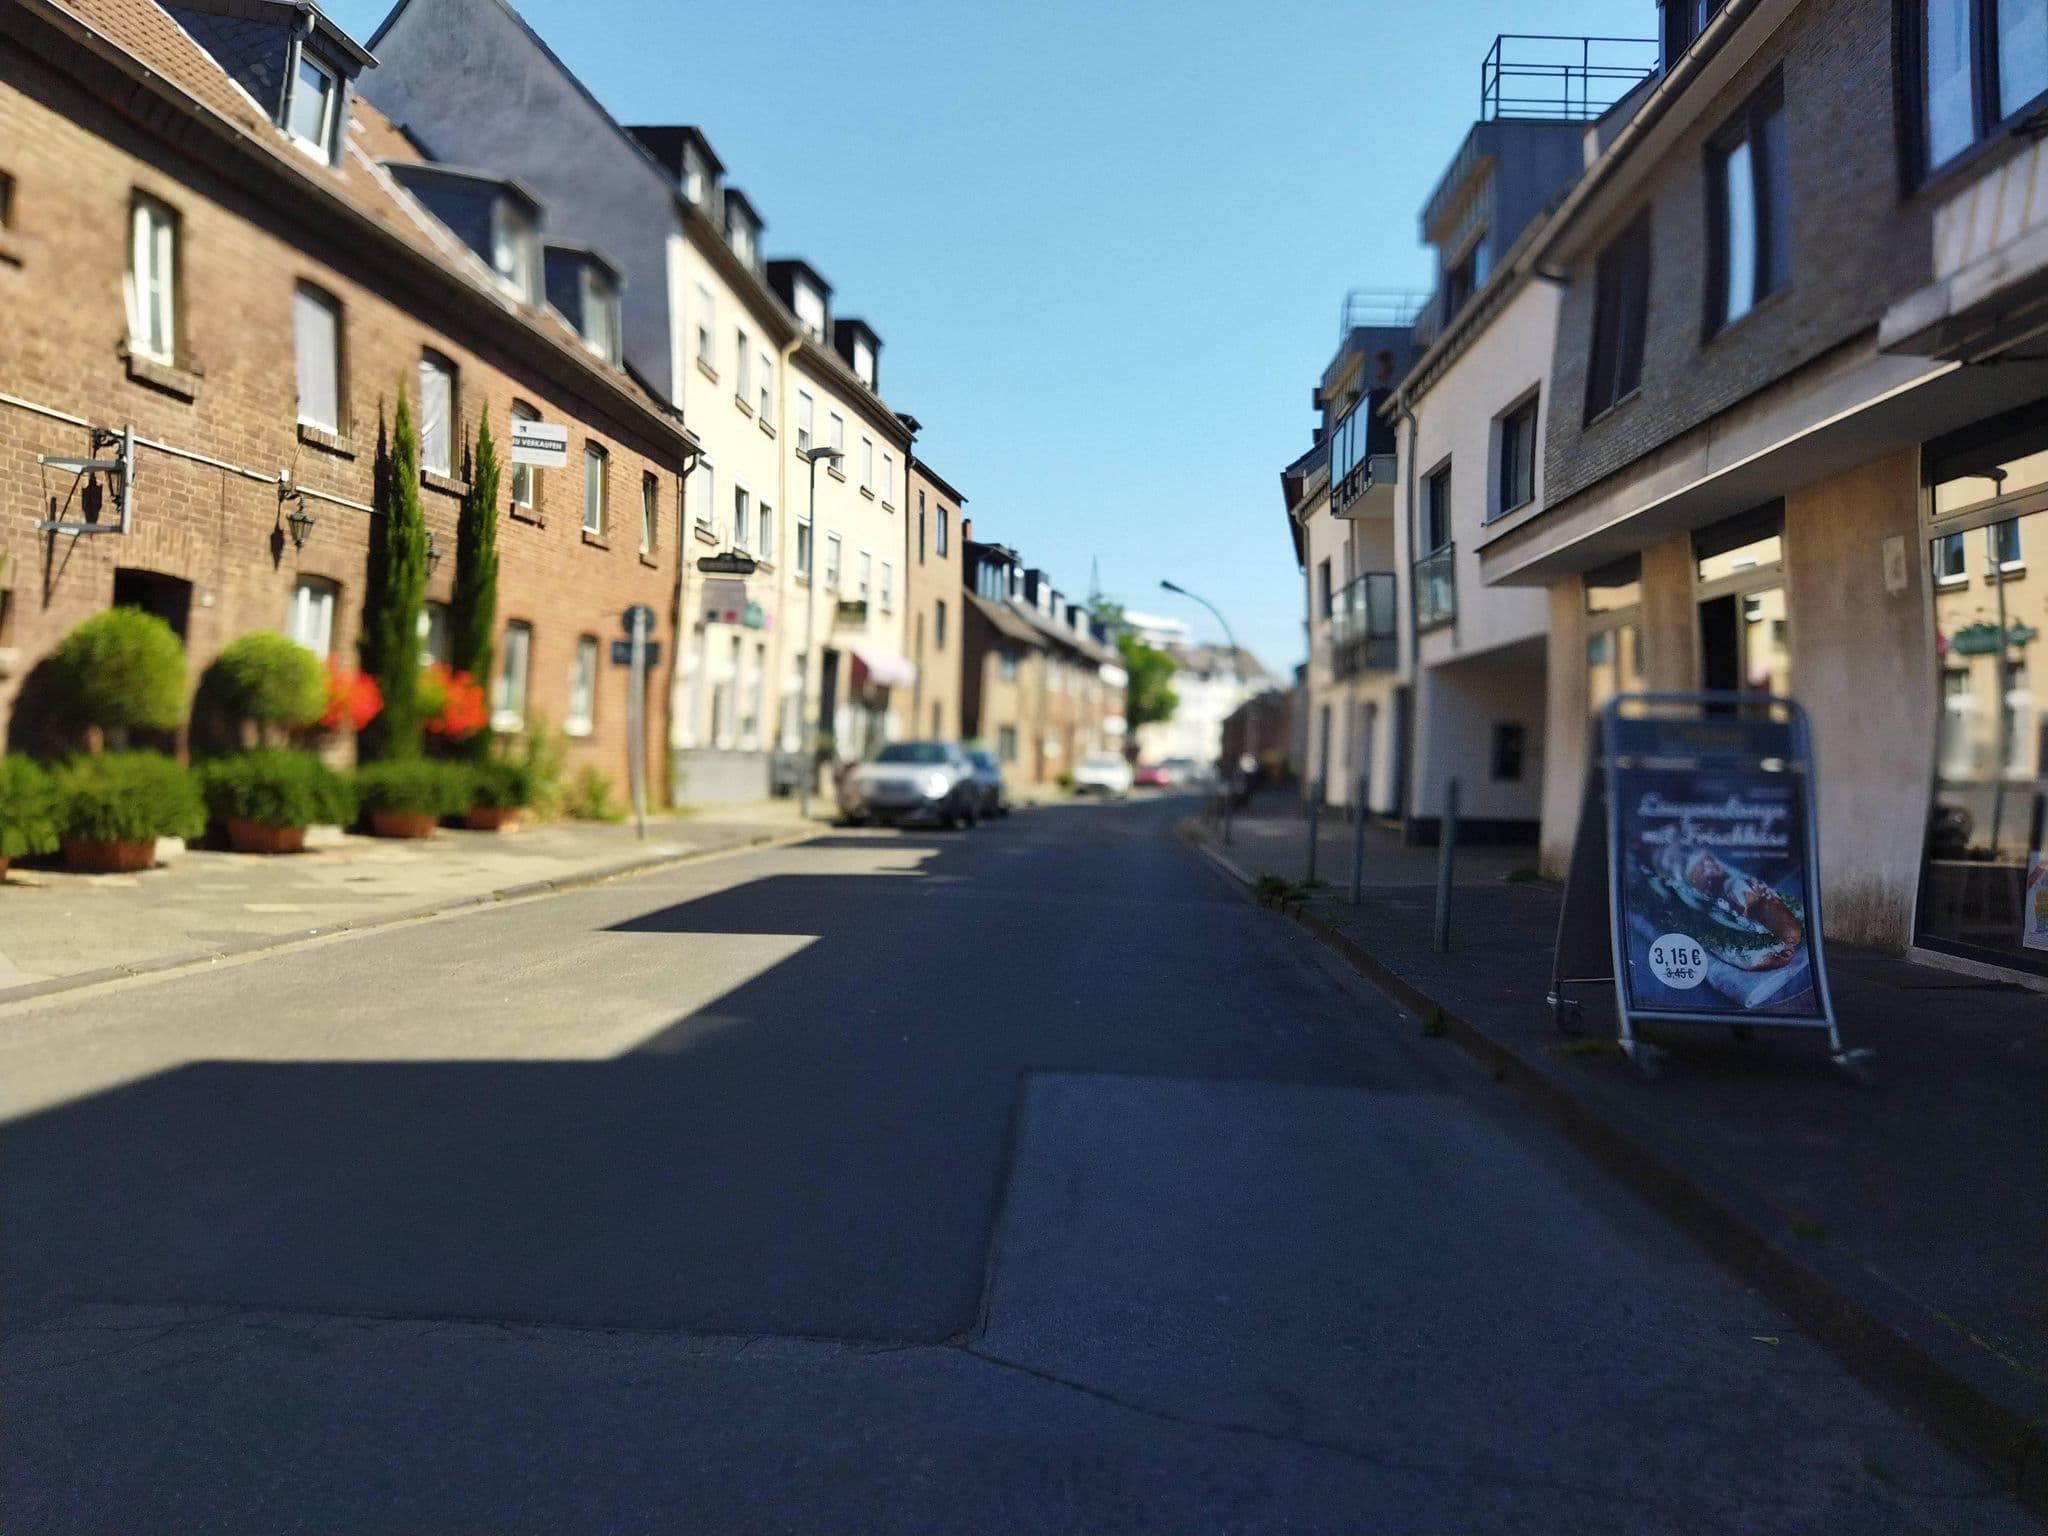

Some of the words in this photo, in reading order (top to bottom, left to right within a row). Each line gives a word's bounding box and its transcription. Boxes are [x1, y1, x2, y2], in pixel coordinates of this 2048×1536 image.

[522, 438, 562, 449] VERKAUFEN
[1654, 947, 1688, 967] 3,15
[1692, 948, 1701, 966] €
[1666, 967, 1687, 979] 3,45
